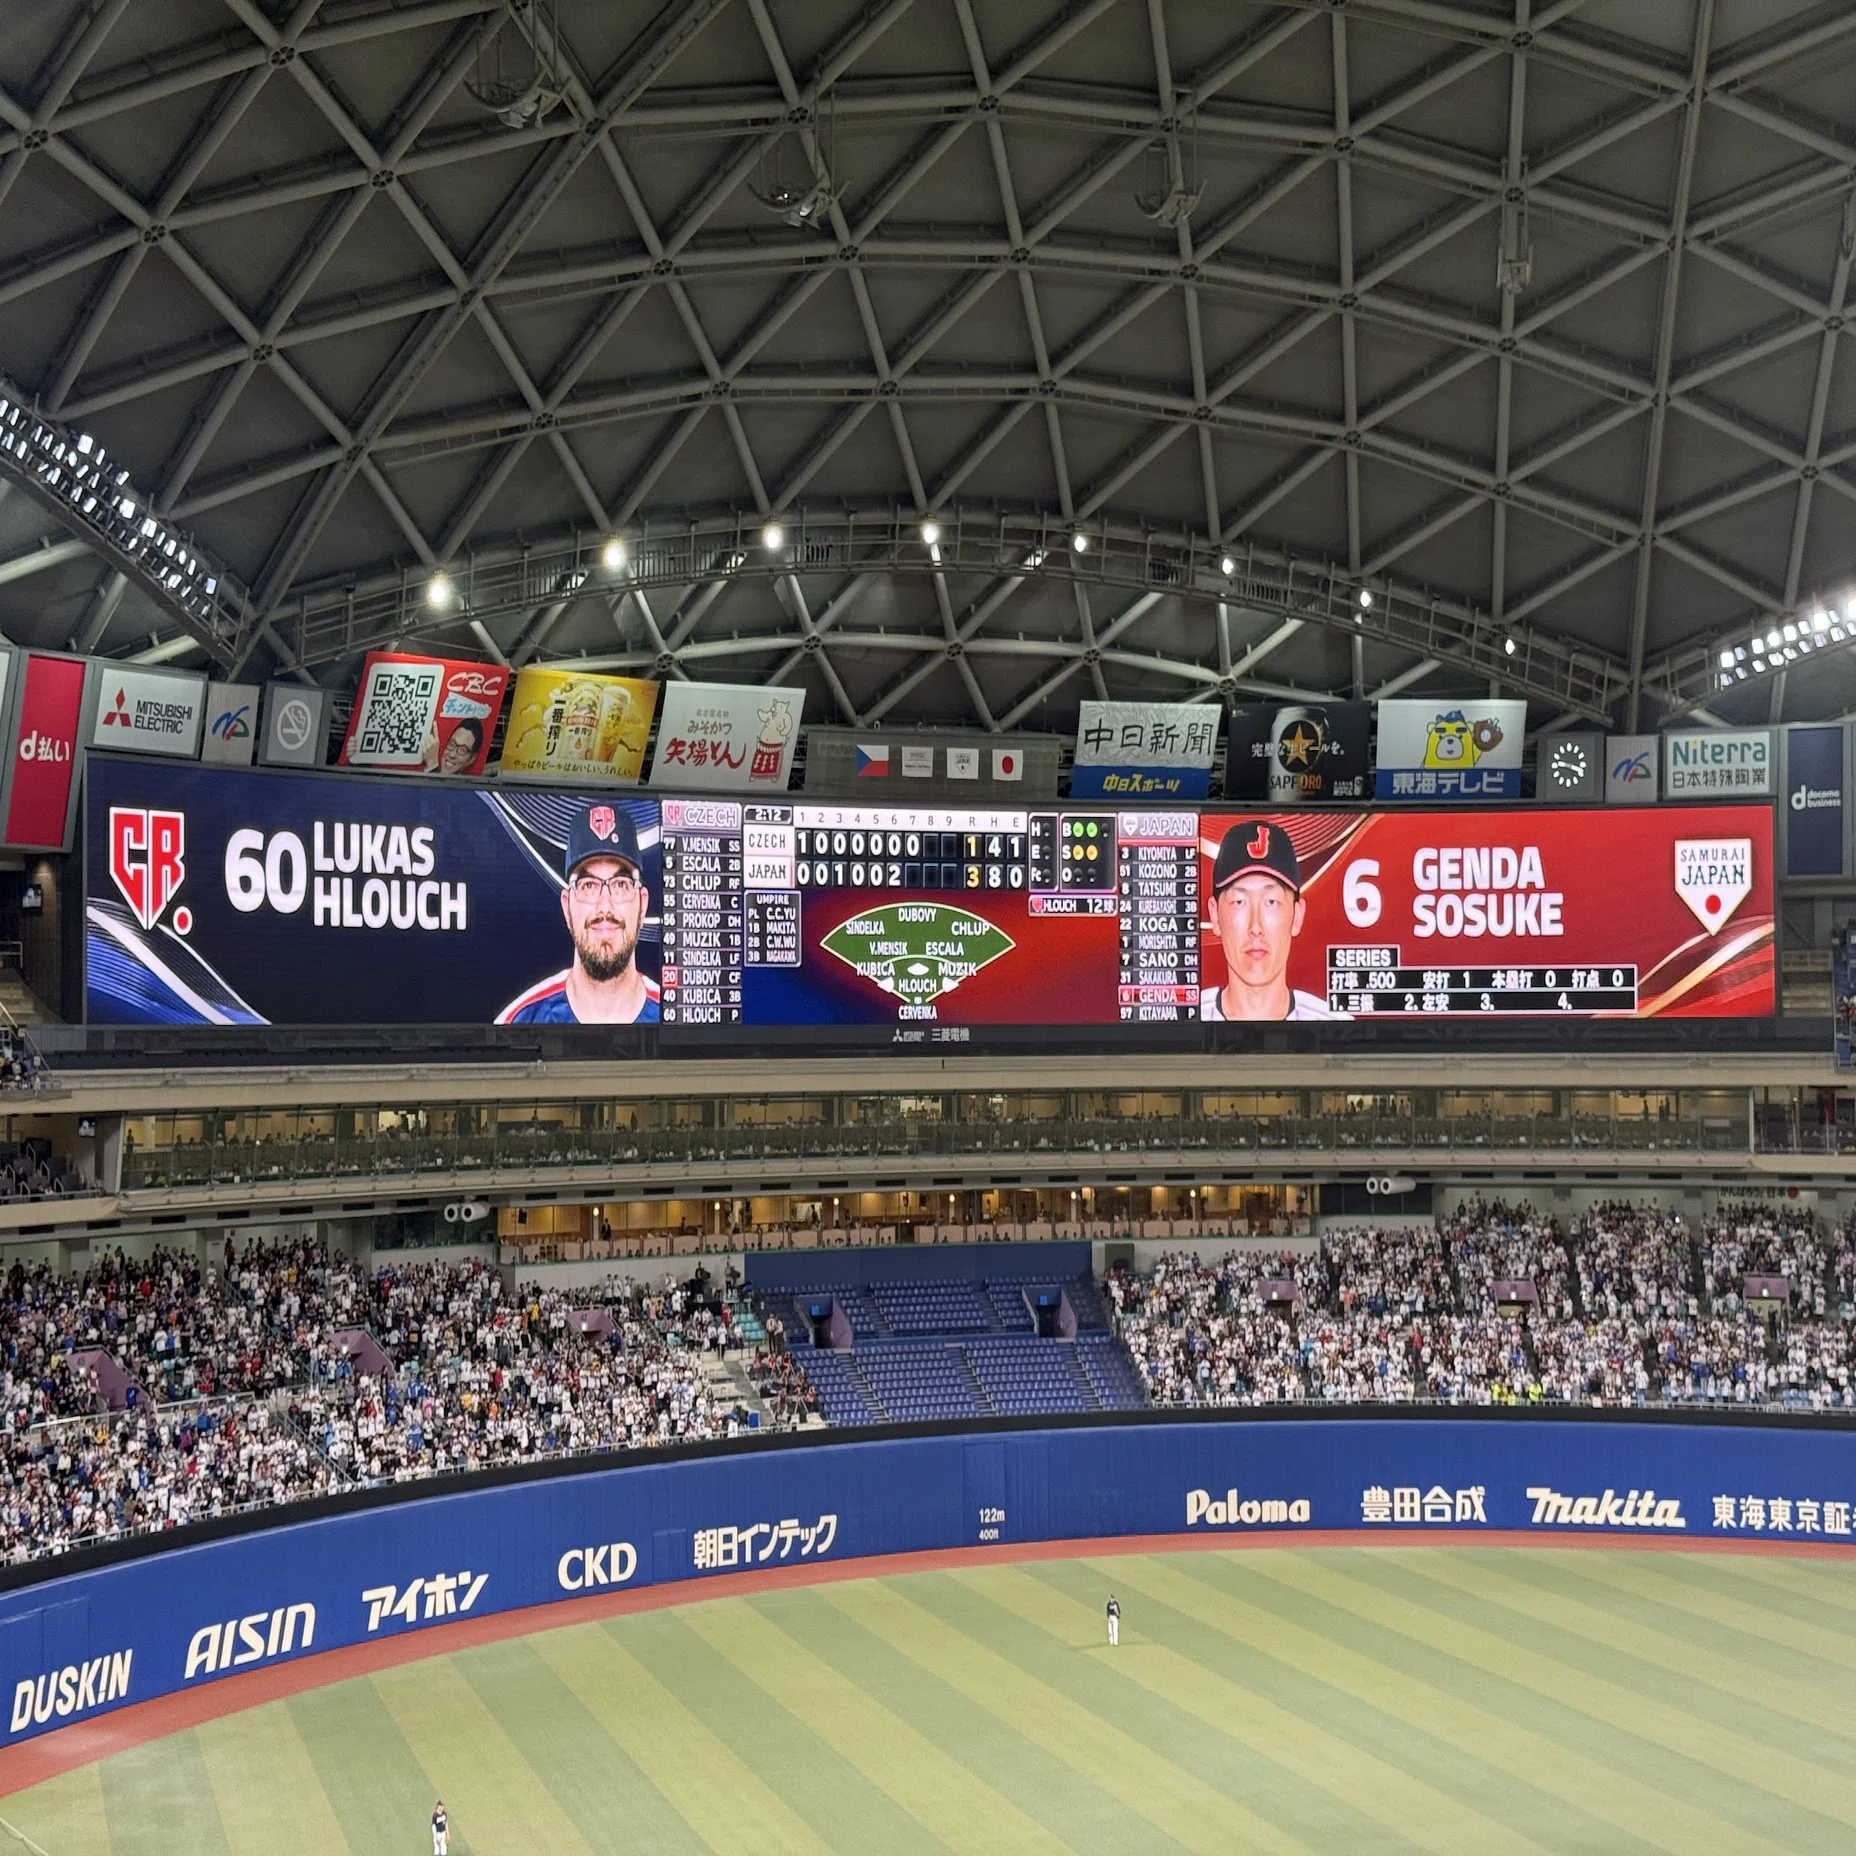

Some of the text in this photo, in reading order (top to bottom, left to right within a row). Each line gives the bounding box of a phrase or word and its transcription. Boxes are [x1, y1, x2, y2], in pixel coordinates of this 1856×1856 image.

[447, 672, 502, 695] CBC
[136, 700, 193, 720] MITSUBISHI
[134, 714, 183, 734] ELECTRIC
[546, 700, 566, 756] 一番搾り
[687, 720, 732, 735] みそかつ
[1084, 718, 1214, 756] 中日新聞
[19, 730, 70, 762] d払い
[663, 737, 747, 769] 矢場とん
[1251, 741, 1345, 758] 完璧な生ビールを。
[1672, 740, 1766, 767] Niterra
[1102, 773, 1180, 793] 中日スポーツ
[1269, 775, 1322, 791] SAPPORO
[1392, 773, 1505, 795] 東海テレビ
[1672, 768, 1766, 789] 日本特殊陶業
[1807, 798, 1841, 808] business
[684, 808, 738, 828] CZECH
[755, 809, 782, 821] 2:12
[1032, 822, 1072, 837] H B
[1140, 816, 1194, 836] JAPAN
[313, 821, 435, 876] LUKAS
[663, 837, 740, 853] 77 V.MENSIK SS
[749, 832, 1019, 858] CZECH 1 0 0 0 0 0 0 1 4 1
[1246, 825, 1270, 859] J
[1032, 845, 1071, 860] E S
[1122, 847, 1196, 860] 3 KIYOMIYA LF
[1680, 848, 1745, 862] SAMURAI
[224, 828, 307, 914] 60
[665, 856, 741, 872] 5 ESCALA 2B
[1139, 864, 1197, 879] KOZONO 2B
[1412, 846, 1545, 891] GENDA
[663, 875, 740, 891] 73 CHLUP RF
[749, 863, 1022, 888] JAPAN 0 0 1 0 0 2 3 8 0
[1062, 868, 1072, 882] O
[1682, 865, 1744, 885] JAPAN
[1122, 882, 1197, 896] 8 TATSUMI CF
[1342, 858, 1382, 929] 6
[313, 876, 467, 931] HLOUCH
[663, 894, 738, 909] 55 CERVENKA C
[756, 895, 789, 905] UMPIRE
[1044, 899, 1077, 912] HLOUCH
[1120, 901, 1132, 912] 24
[1185, 901, 1197, 912] 3B
[663, 913, 741, 928] 56 PROKOP DH
[749, 908, 796, 920] PL C.C.YU
[898, 908, 937, 922] DUBOVY
[1412, 892, 1564, 938] SOSUKE
[749, 922, 796, 934] 1B MAKITA
[846, 921, 885, 935] SINDELKA
[951, 921, 990, 936] CHLUP
[1120, 917, 1194, 932] 22 KOGA C
[663, 932, 741, 947] 49 MUZIK 1B
[748, 936, 796, 949] 2B C.W.WU
[1122, 935, 1197, 950] 1 MORISHITA RF
[748, 951, 760, 962] 3B
[869, 942, 908, 955] V.MENSIK
[926, 942, 964, 956] ESCALA
[663, 951, 740, 966] 11 SINDELKA LF
[1122, 952, 1198, 968] 7 SANO DH
[1335, 950, 1391, 967] SERIES
[664, 969, 741, 985] 20 DUBOVY CF
[856, 962, 895, 976] KUBICA
[938, 962, 977, 976] MUZIK
[1120, 970, 1197, 984] 31 SAKAKURA 1B
[899, 979, 937, 993] HLOUCH
[1332, 970, 1624, 990] 打率 .500 安打 1 本塁打 0 打点 0
[663, 988, 741, 1004] 40 KUBICA 3B
[1122, 989, 1197, 1003] 6 GENDA SS
[1332, 993, 1572, 1012] 1. 三振 2. 左安 3. 4.
[663, 1007, 738, 1023] 60 HLOUCH P
[898, 1005, 938, 1020] CERVENKA
[1139, 1006, 1178, 1020] KITAYAMA
[1188, 1008, 1195, 1019] P
[931, 1027, 970, 1042] 三菱電機
[1186, 1488, 1310, 1525] Paloma
[1360, 1485, 1488, 1523] 豊田合成
[980, 1508, 1005, 1523] 122m
[693, 1514, 838, 1569] 朝日インテック
[979, 1528, 999, 1540] 400ft
[557, 1541, 637, 1591] CKD
[361, 1570, 489, 1631] アイホン
[183, 1601, 316, 1680] AISIN
[9, 1648, 132, 1734] DUSKIN
